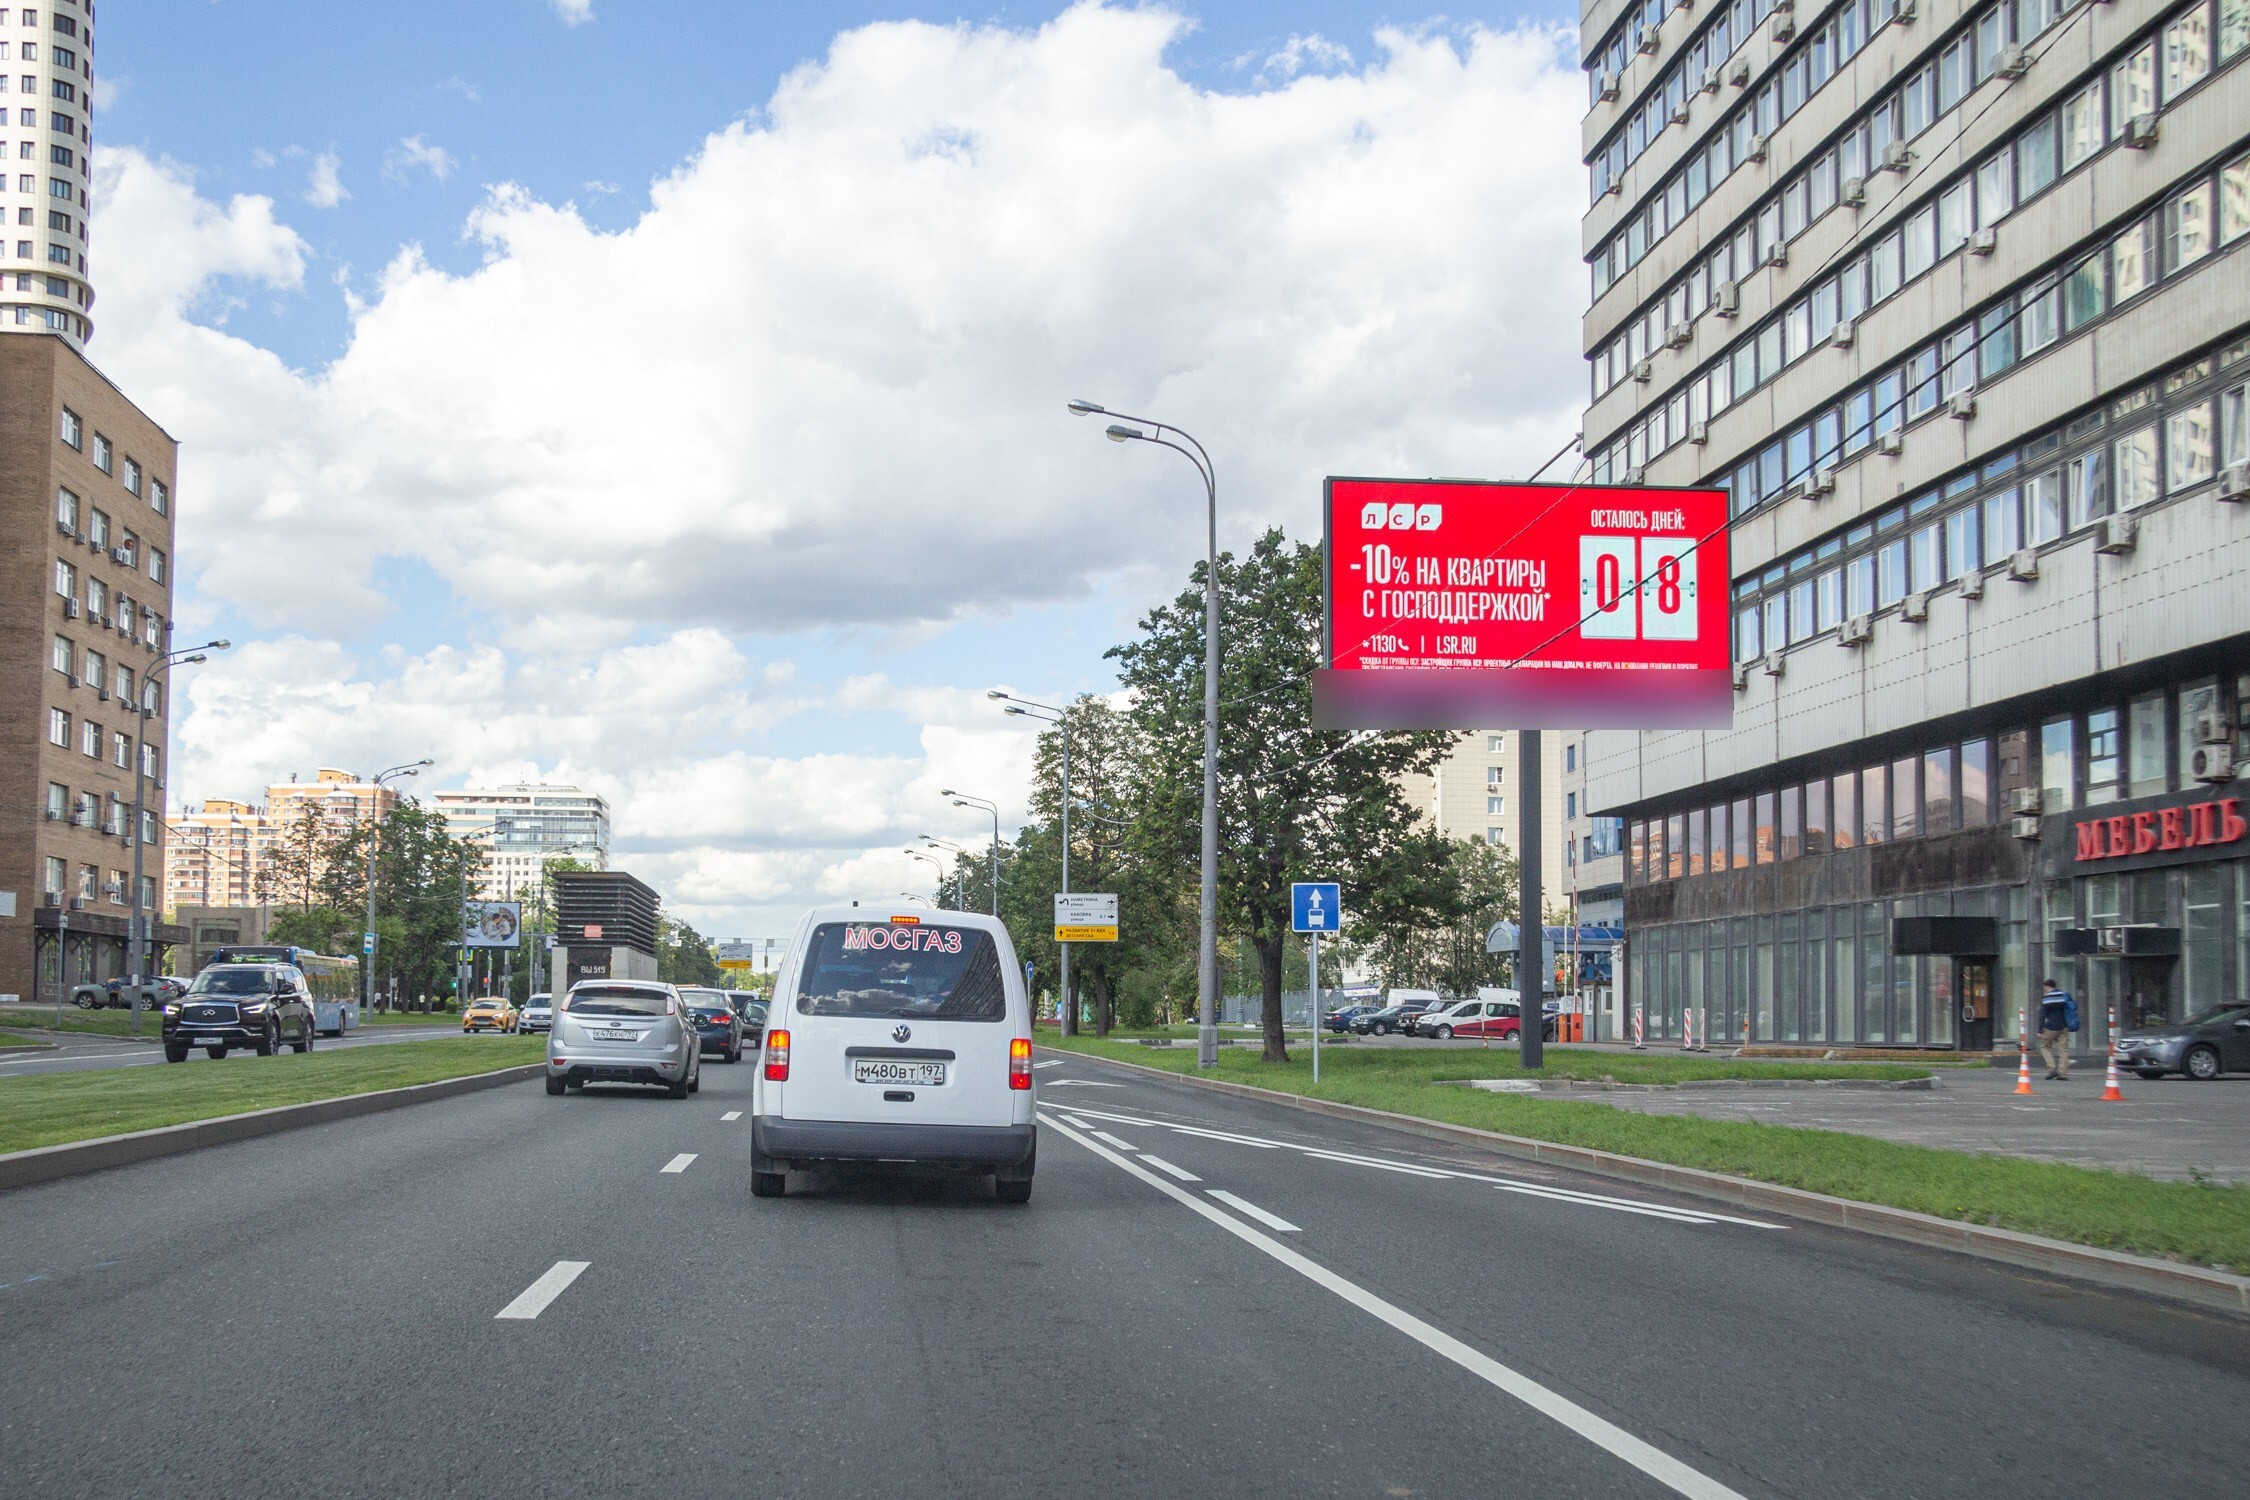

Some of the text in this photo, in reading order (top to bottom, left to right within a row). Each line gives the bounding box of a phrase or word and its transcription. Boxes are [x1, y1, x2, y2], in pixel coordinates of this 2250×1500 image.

[1590, 508, 1686, 532] ОСТАЛОСЬ ДНЕЙ:
[1350, 544, 1546, 588] -10% НА КВАРТИРЫ
[1362, 589, 1375, 618] С
[1436, 636, 1477, 654] LSR.RU
[2074, 797, 2247, 862] МЕБЕЛЬ
[844, 927, 962, 954] МОСГАЗ
[580, 966, 606, 974] ВШ 519
[920, 1066, 940, 1076] 197
